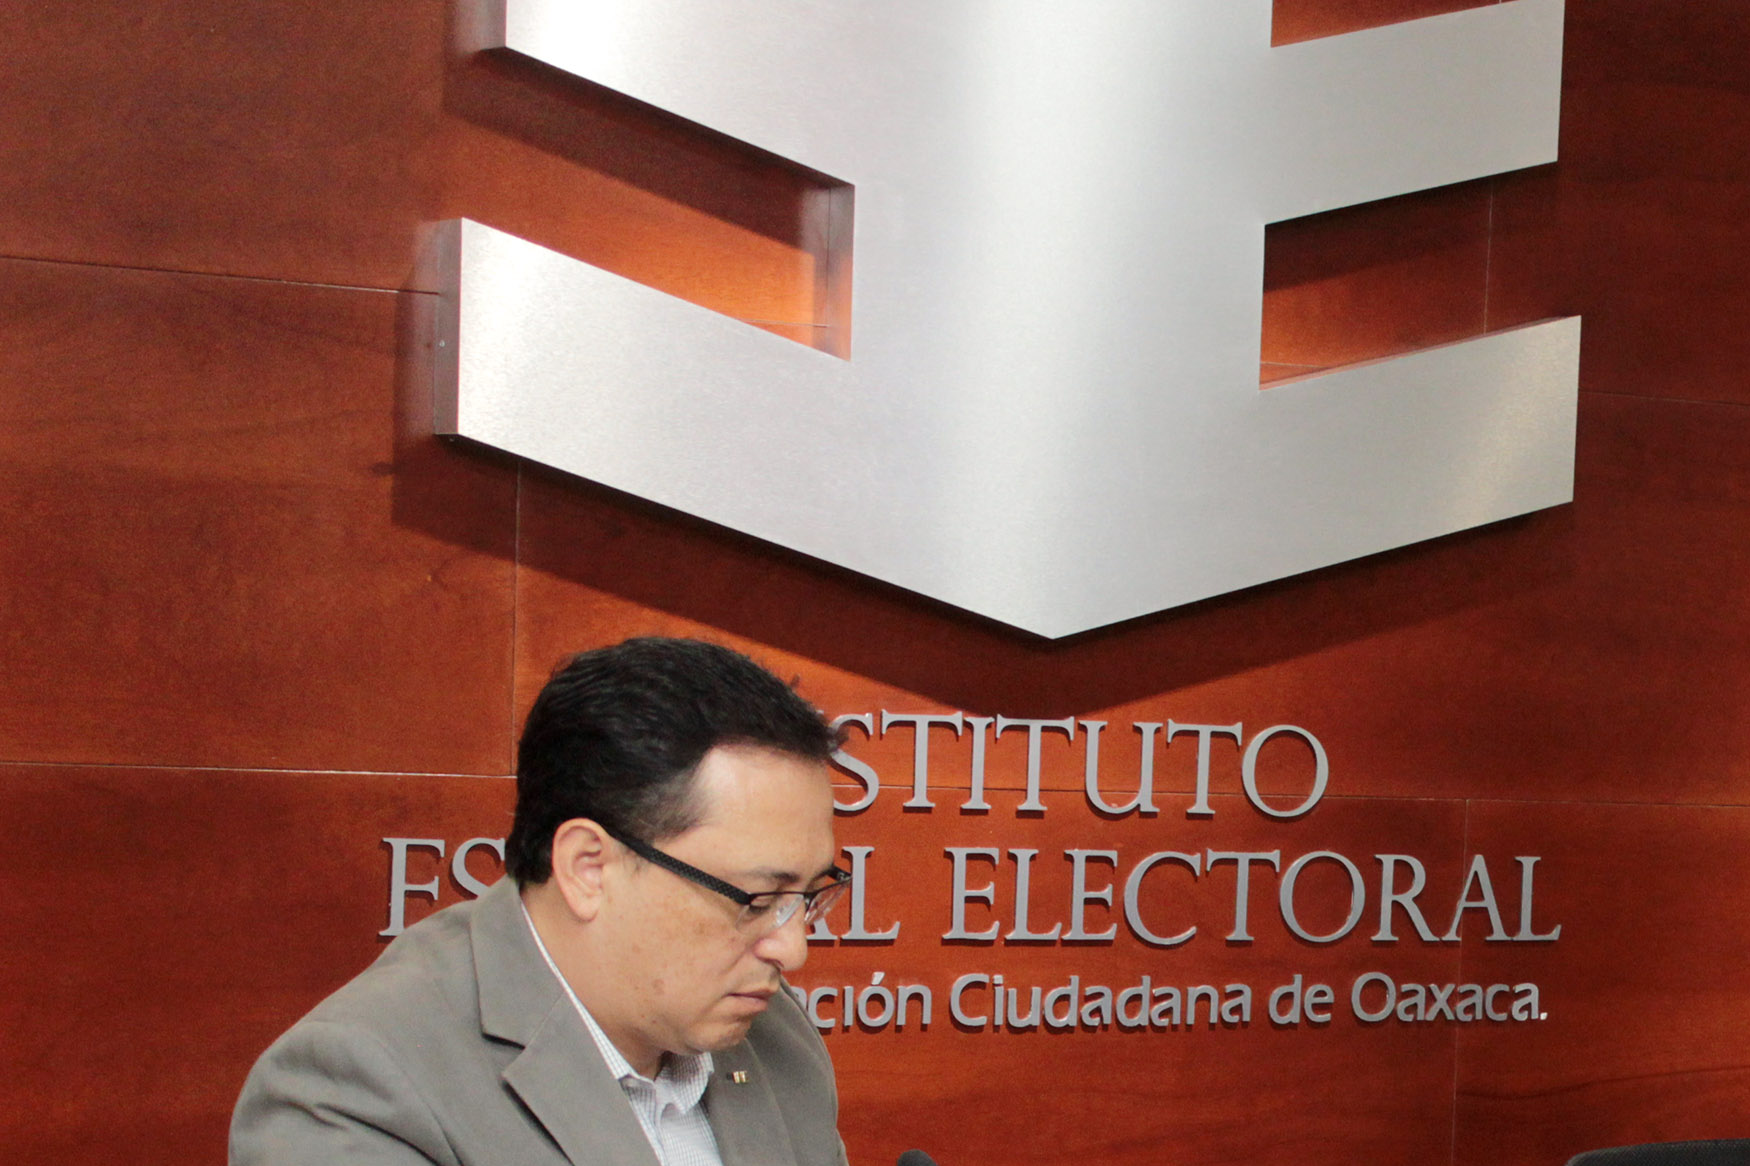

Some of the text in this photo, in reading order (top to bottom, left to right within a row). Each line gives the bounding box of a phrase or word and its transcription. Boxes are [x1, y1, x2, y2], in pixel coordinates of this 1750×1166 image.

[822, 709, 1329, 818] STITUTO
[942, 847, 1561, 945] ELECTORAL
[950, 973, 1252, 1028] Ciudadana
[1268, 973, 1334, 1025] de
[1351, 971, 1548, 1023] Oaxaca.
